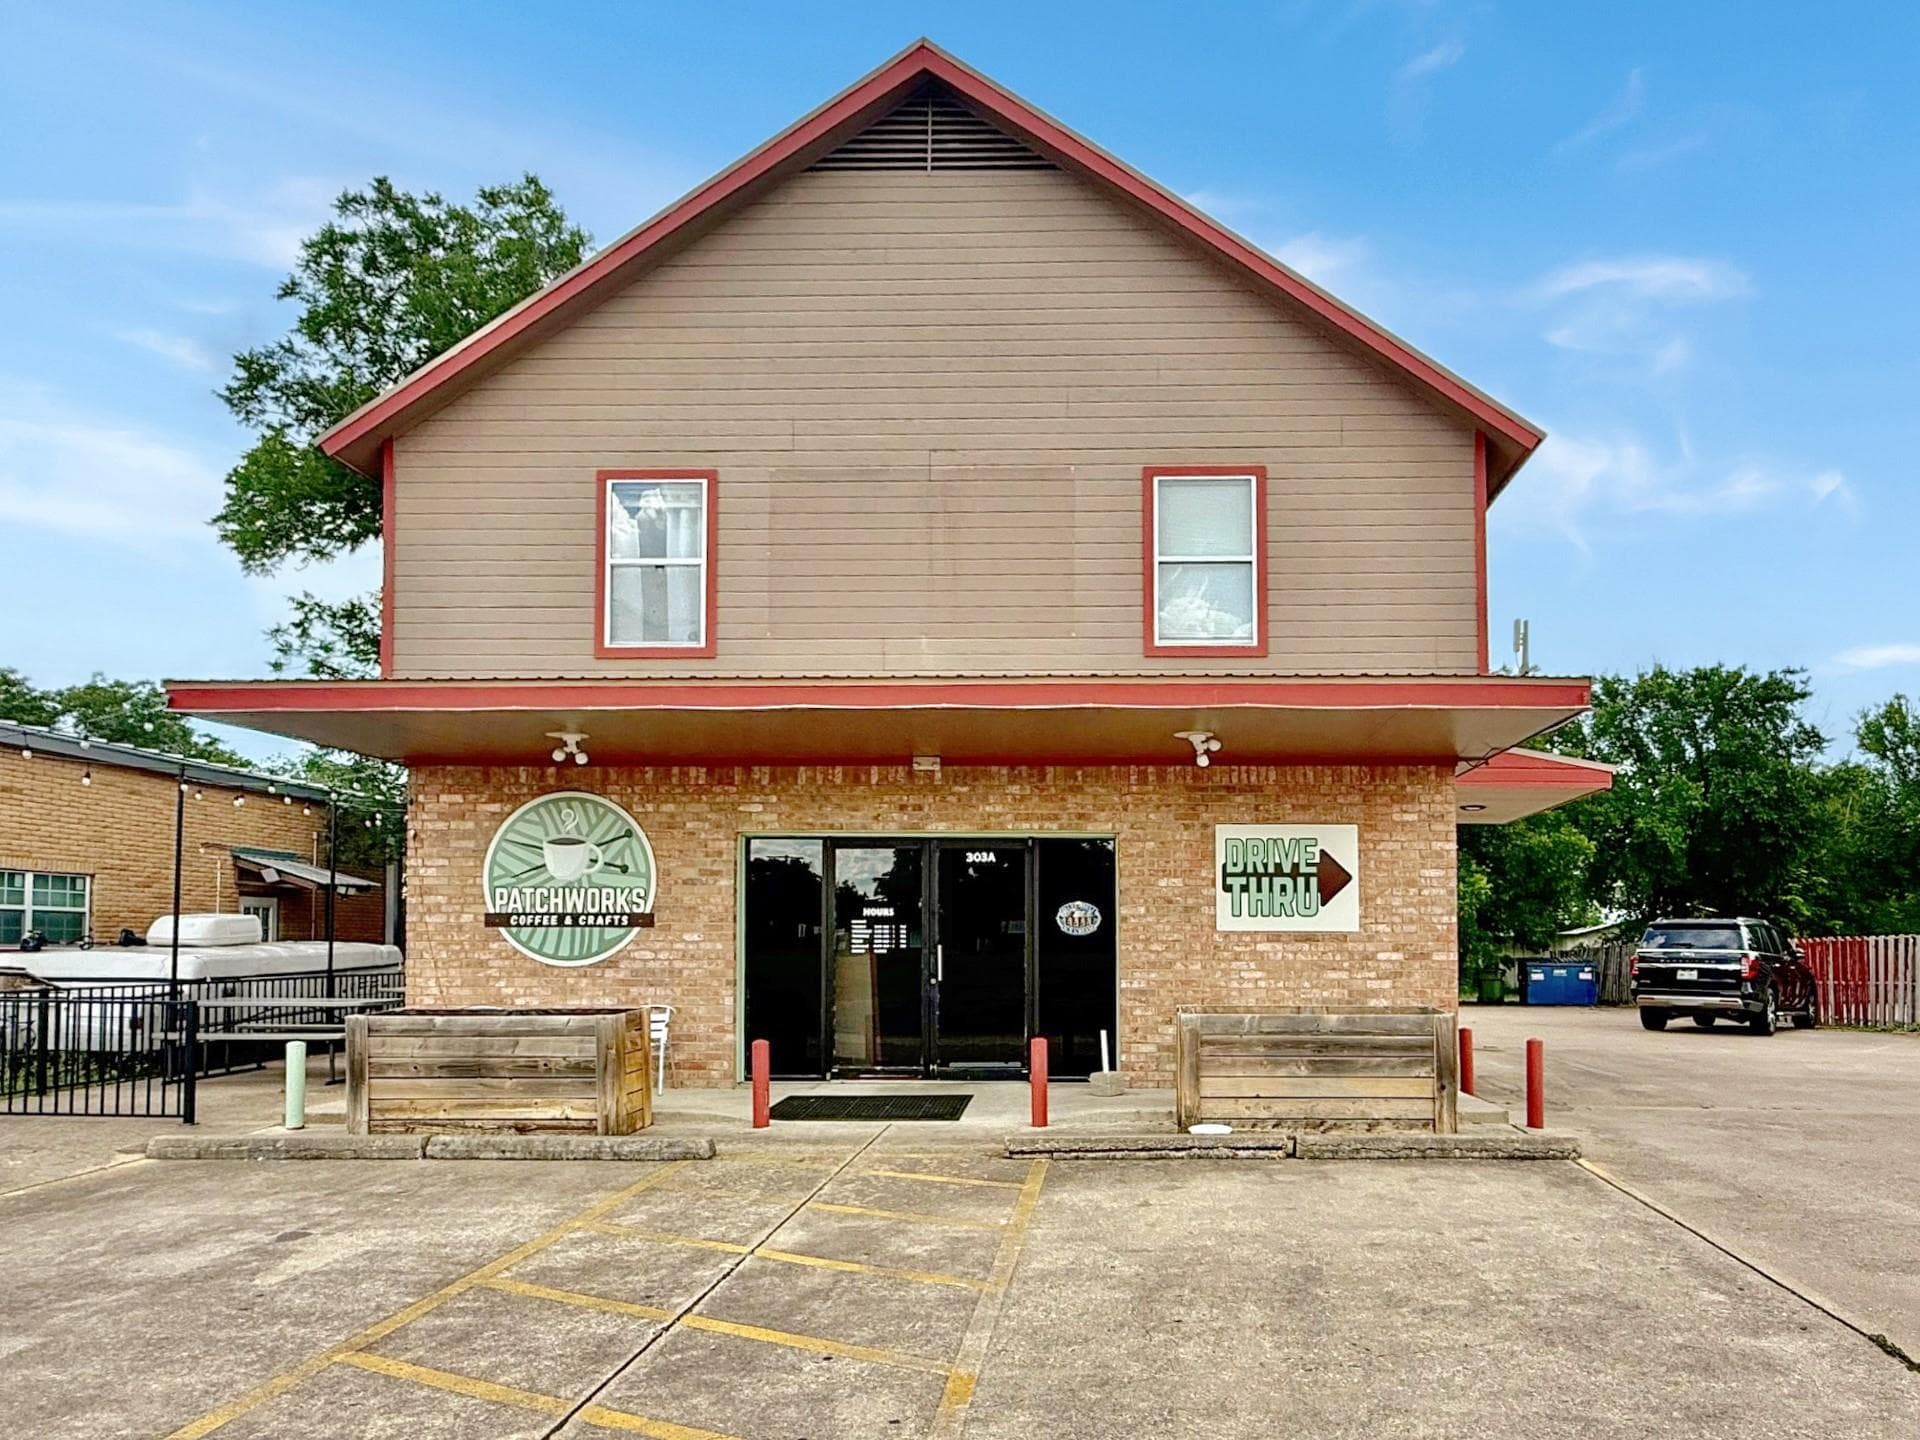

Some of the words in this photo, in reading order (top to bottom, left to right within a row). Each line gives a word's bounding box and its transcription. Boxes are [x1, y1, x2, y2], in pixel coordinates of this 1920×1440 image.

[965, 851, 996, 863] 303A
[1225, 838, 1318, 874] DRIVE
[494, 886, 647, 914] PATCHWORKS
[1225, 876, 1319, 917] THRU
[510, 914, 558, 926] COFFEE
[564, 914, 573, 926] &
[578, 914, 629, 926] CRAFTS
[862, 907, 895, 917] HOURS
